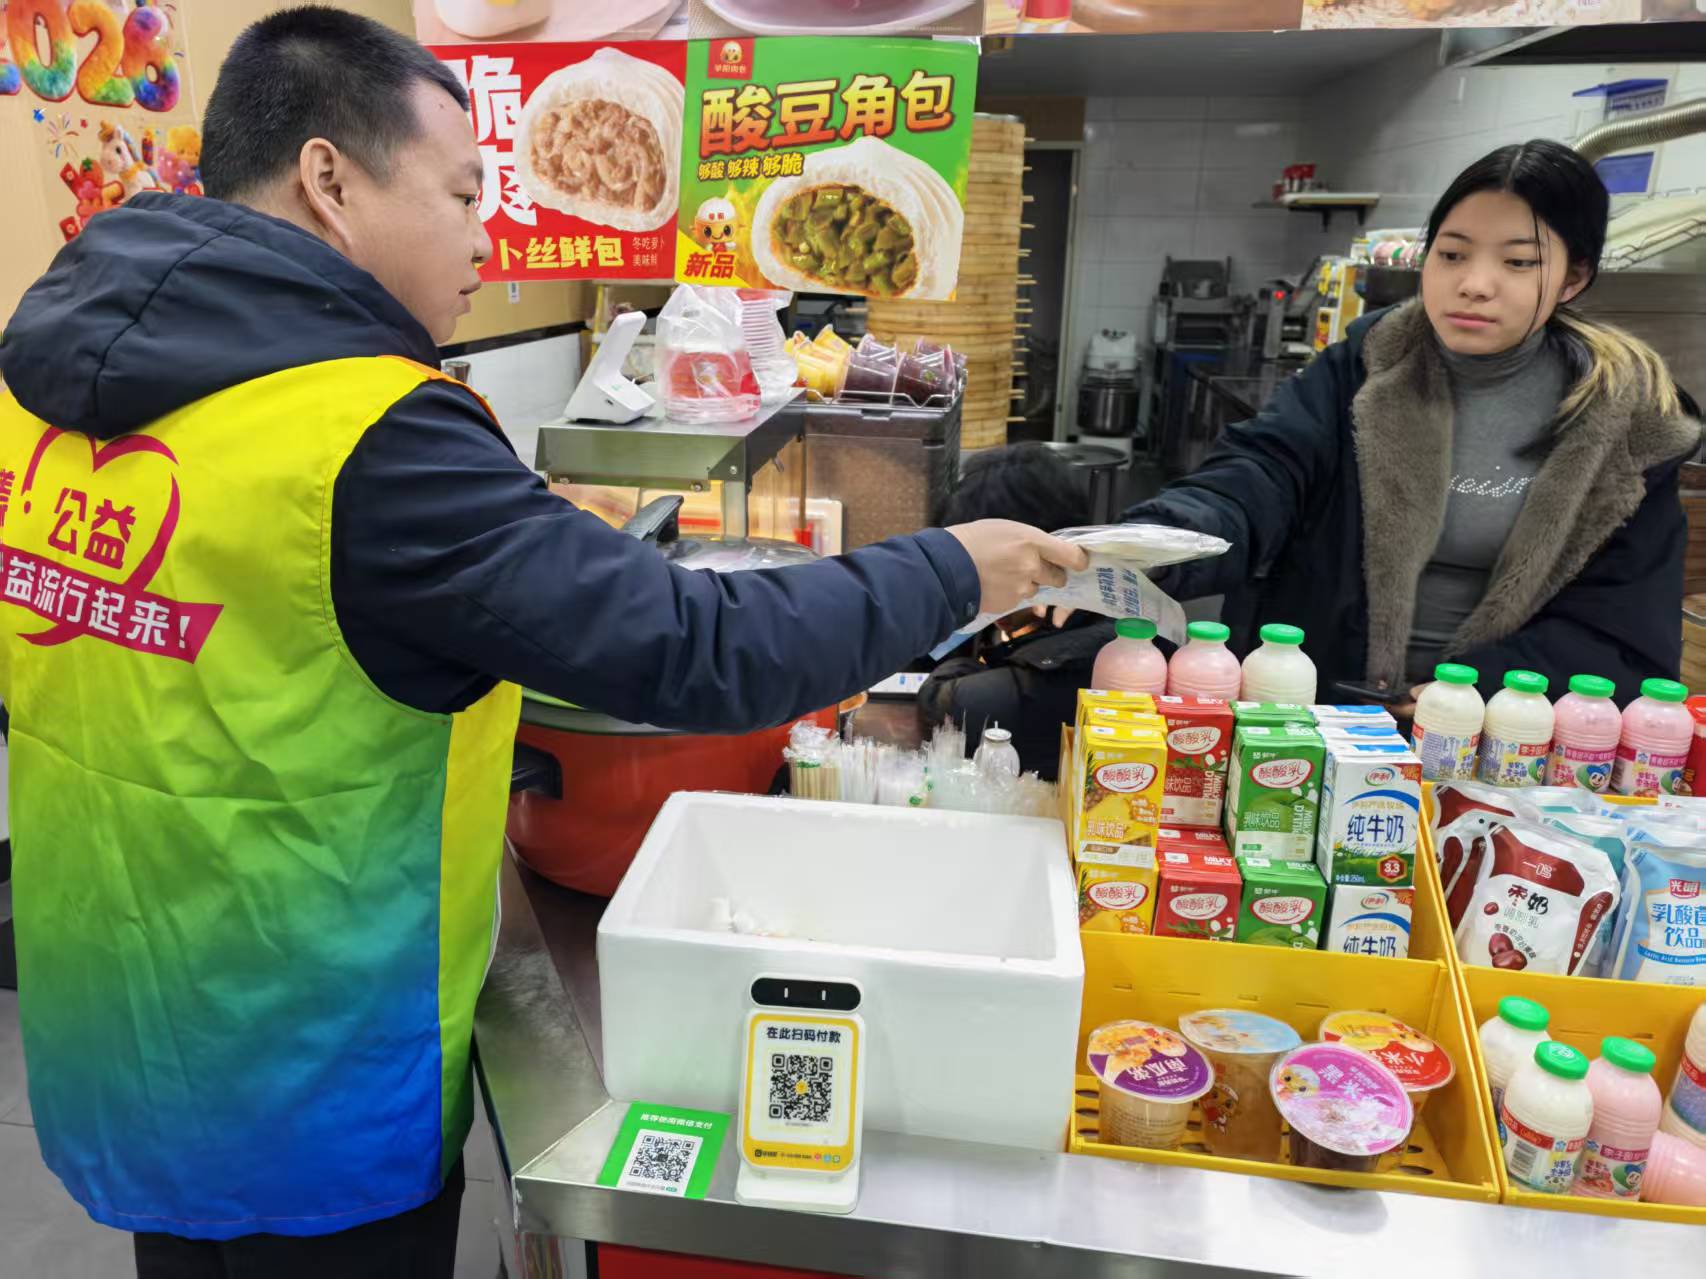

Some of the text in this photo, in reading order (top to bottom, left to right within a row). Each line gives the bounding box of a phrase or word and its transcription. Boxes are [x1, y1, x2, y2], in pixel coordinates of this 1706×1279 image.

[0, 0, 180, 112] 026
[698, 70, 956, 158] 酸豆角包
[762, 152, 806, 177] 够脆
[473, 234, 624, 271] 卜丝鲜包
[684, 251, 737, 279] 新品
[48, 486, 137, 570] 公益
[0, 555, 192, 649] 益流行起来!
[1172, 730, 1215, 746] 酸酸乳
[1102, 766, 1149, 783] 酸酸乳
[1258, 763, 1305, 780] 酸酸乳
[1346, 813, 1405, 844] 纯牛奶
[1384, 862, 1401, 873] 3.3
[1095, 885, 1141, 901] 酸酸乳
[1671, 879, 1698, 892] 光明
[1175, 896, 1222, 911] 酸酸乳
[1258, 900, 1306, 914] 酸酸乳
[1664, 926, 1704, 949] 饮品
[766, 1026, 842, 1044] 在此扫码付款
